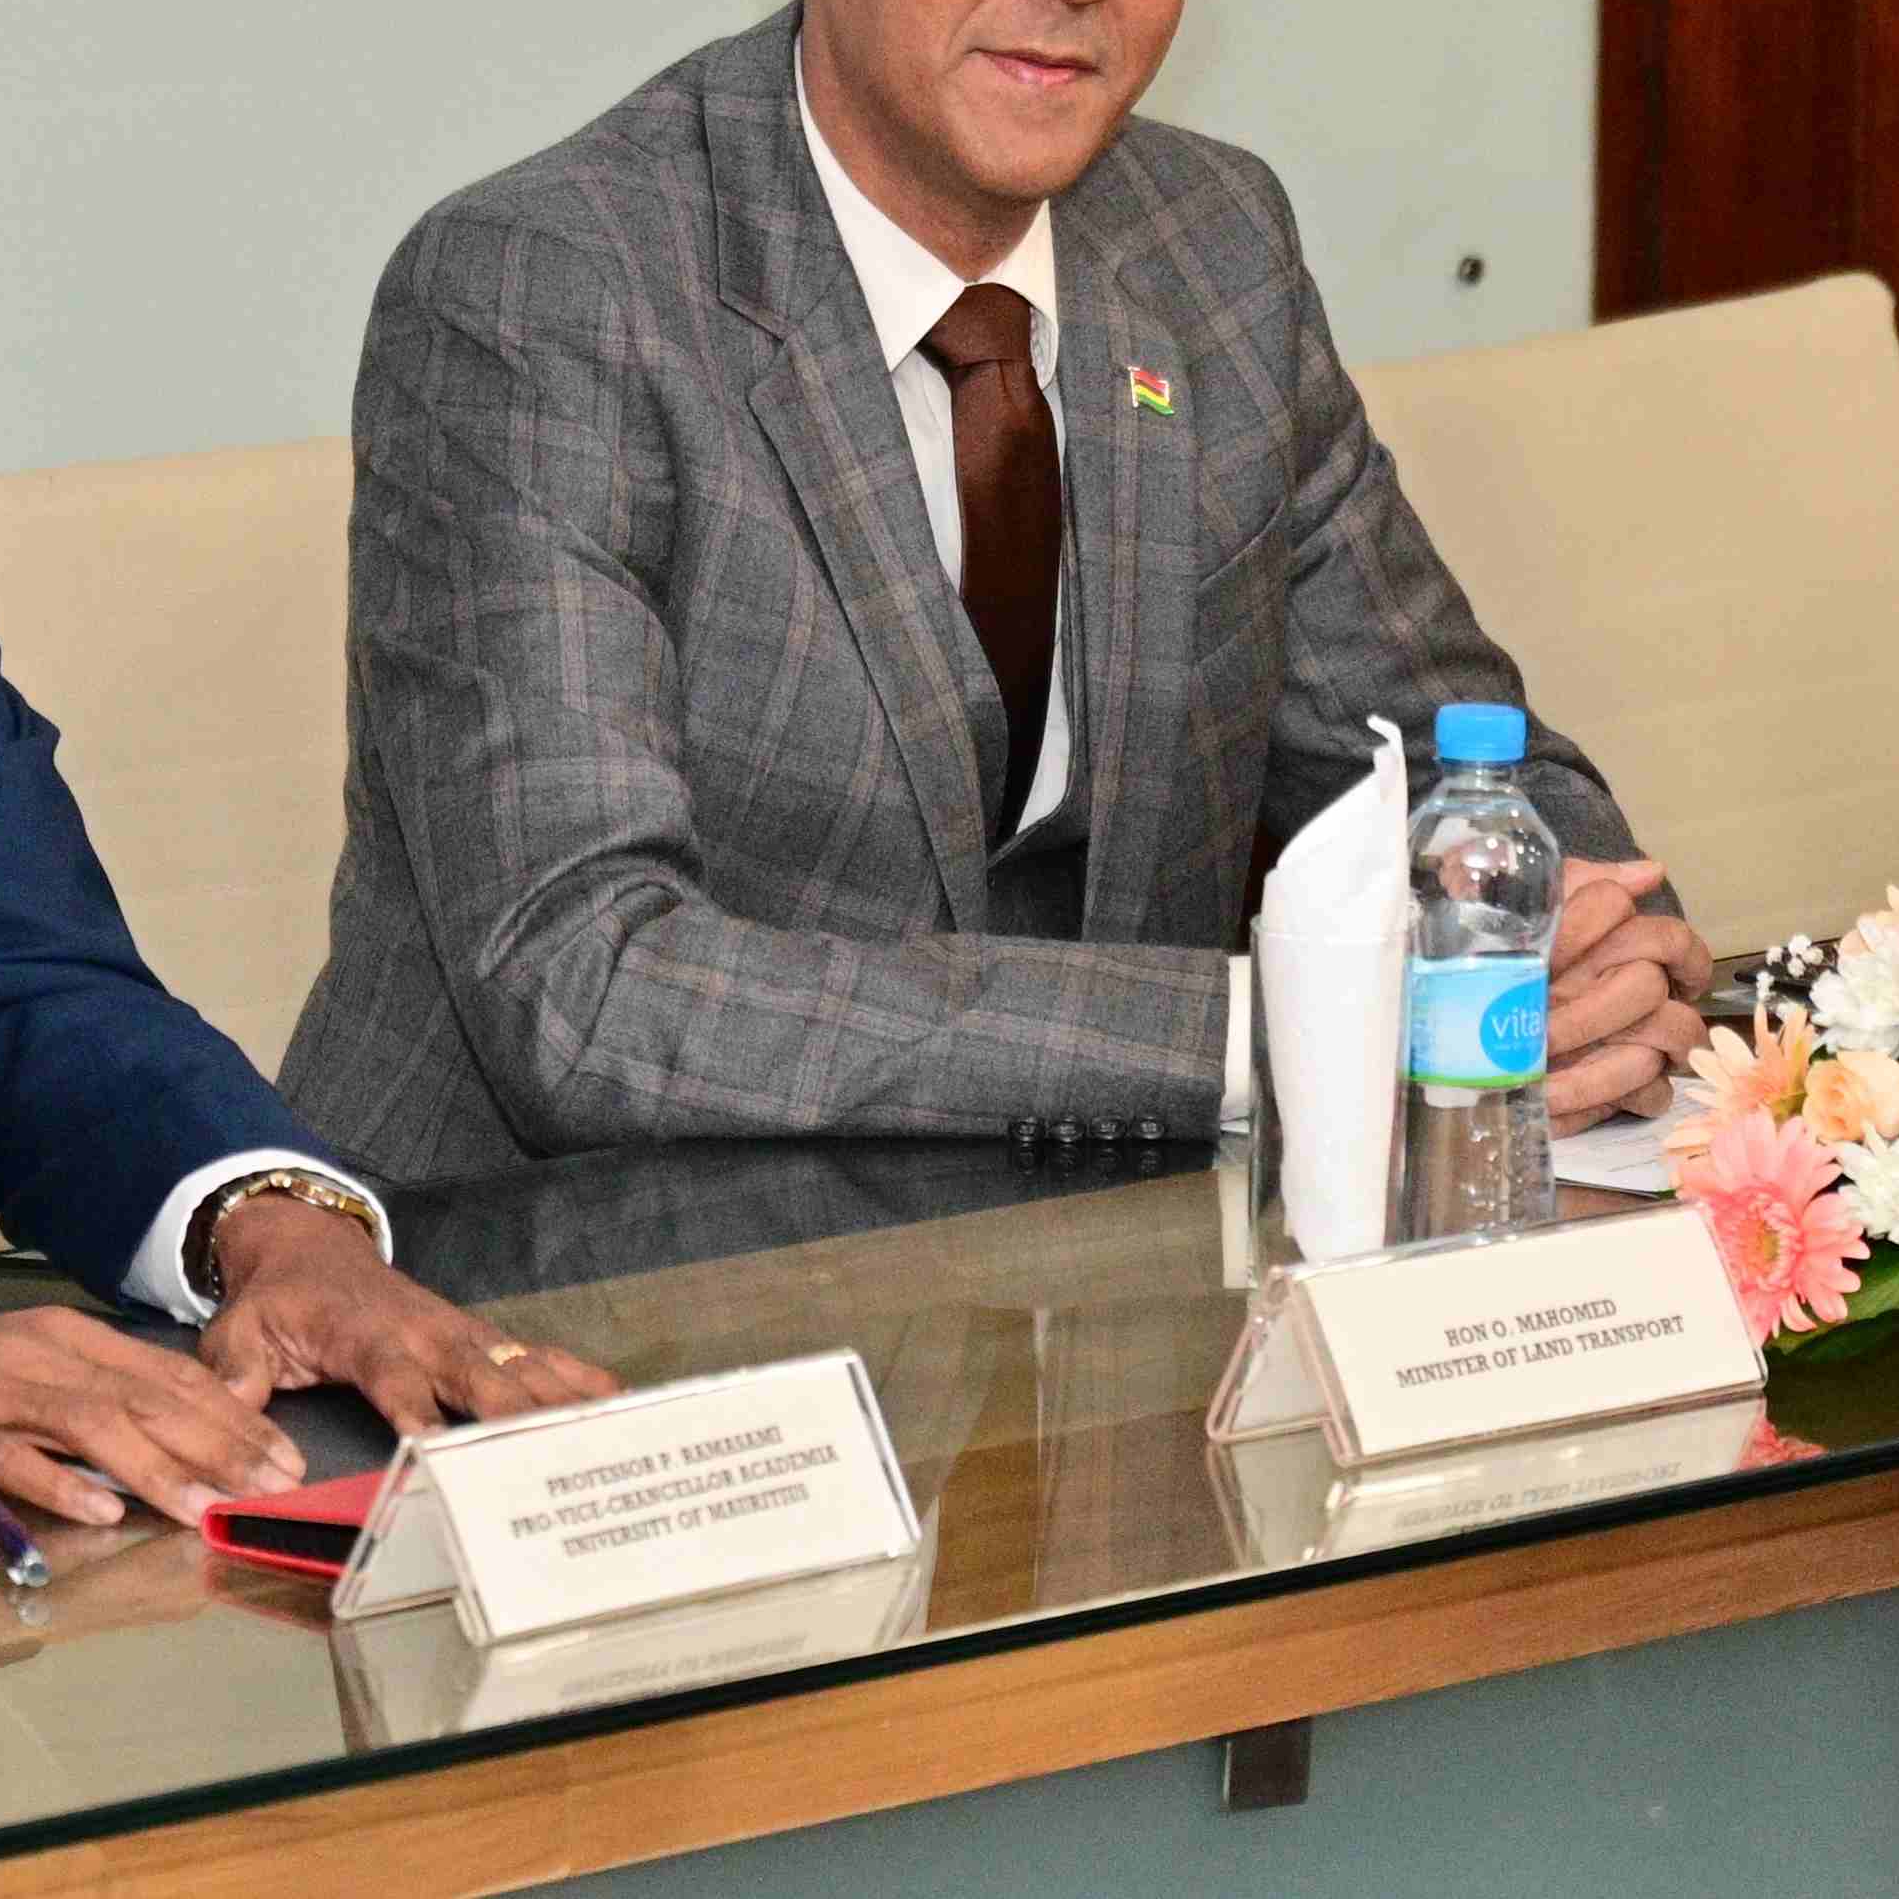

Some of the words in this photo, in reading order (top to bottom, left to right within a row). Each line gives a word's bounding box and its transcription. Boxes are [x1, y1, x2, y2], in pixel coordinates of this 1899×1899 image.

[1395, 1354, 1491, 1389] MINISTER
[1493, 1347, 1519, 1369] OF
[1524, 1337, 1575, 1364] LAND
[1575, 1314, 1685, 1353] TRANSPORT
[1444, 1323, 1489, 1348] HON
[1515, 1298, 1618, 1335] MAHOMED
[510, 1468, 735, 1539] PRO-VICE-CHANCELLOR
[739, 1444, 840, 1483] ACADEMIA
[547, 1455, 658, 1497] PROFESSOR
[562, 1514, 673, 1559] UNIVERSITY
[677, 1507, 702, 1530] OF
[707, 1482, 811, 1521] MAURITIUS
